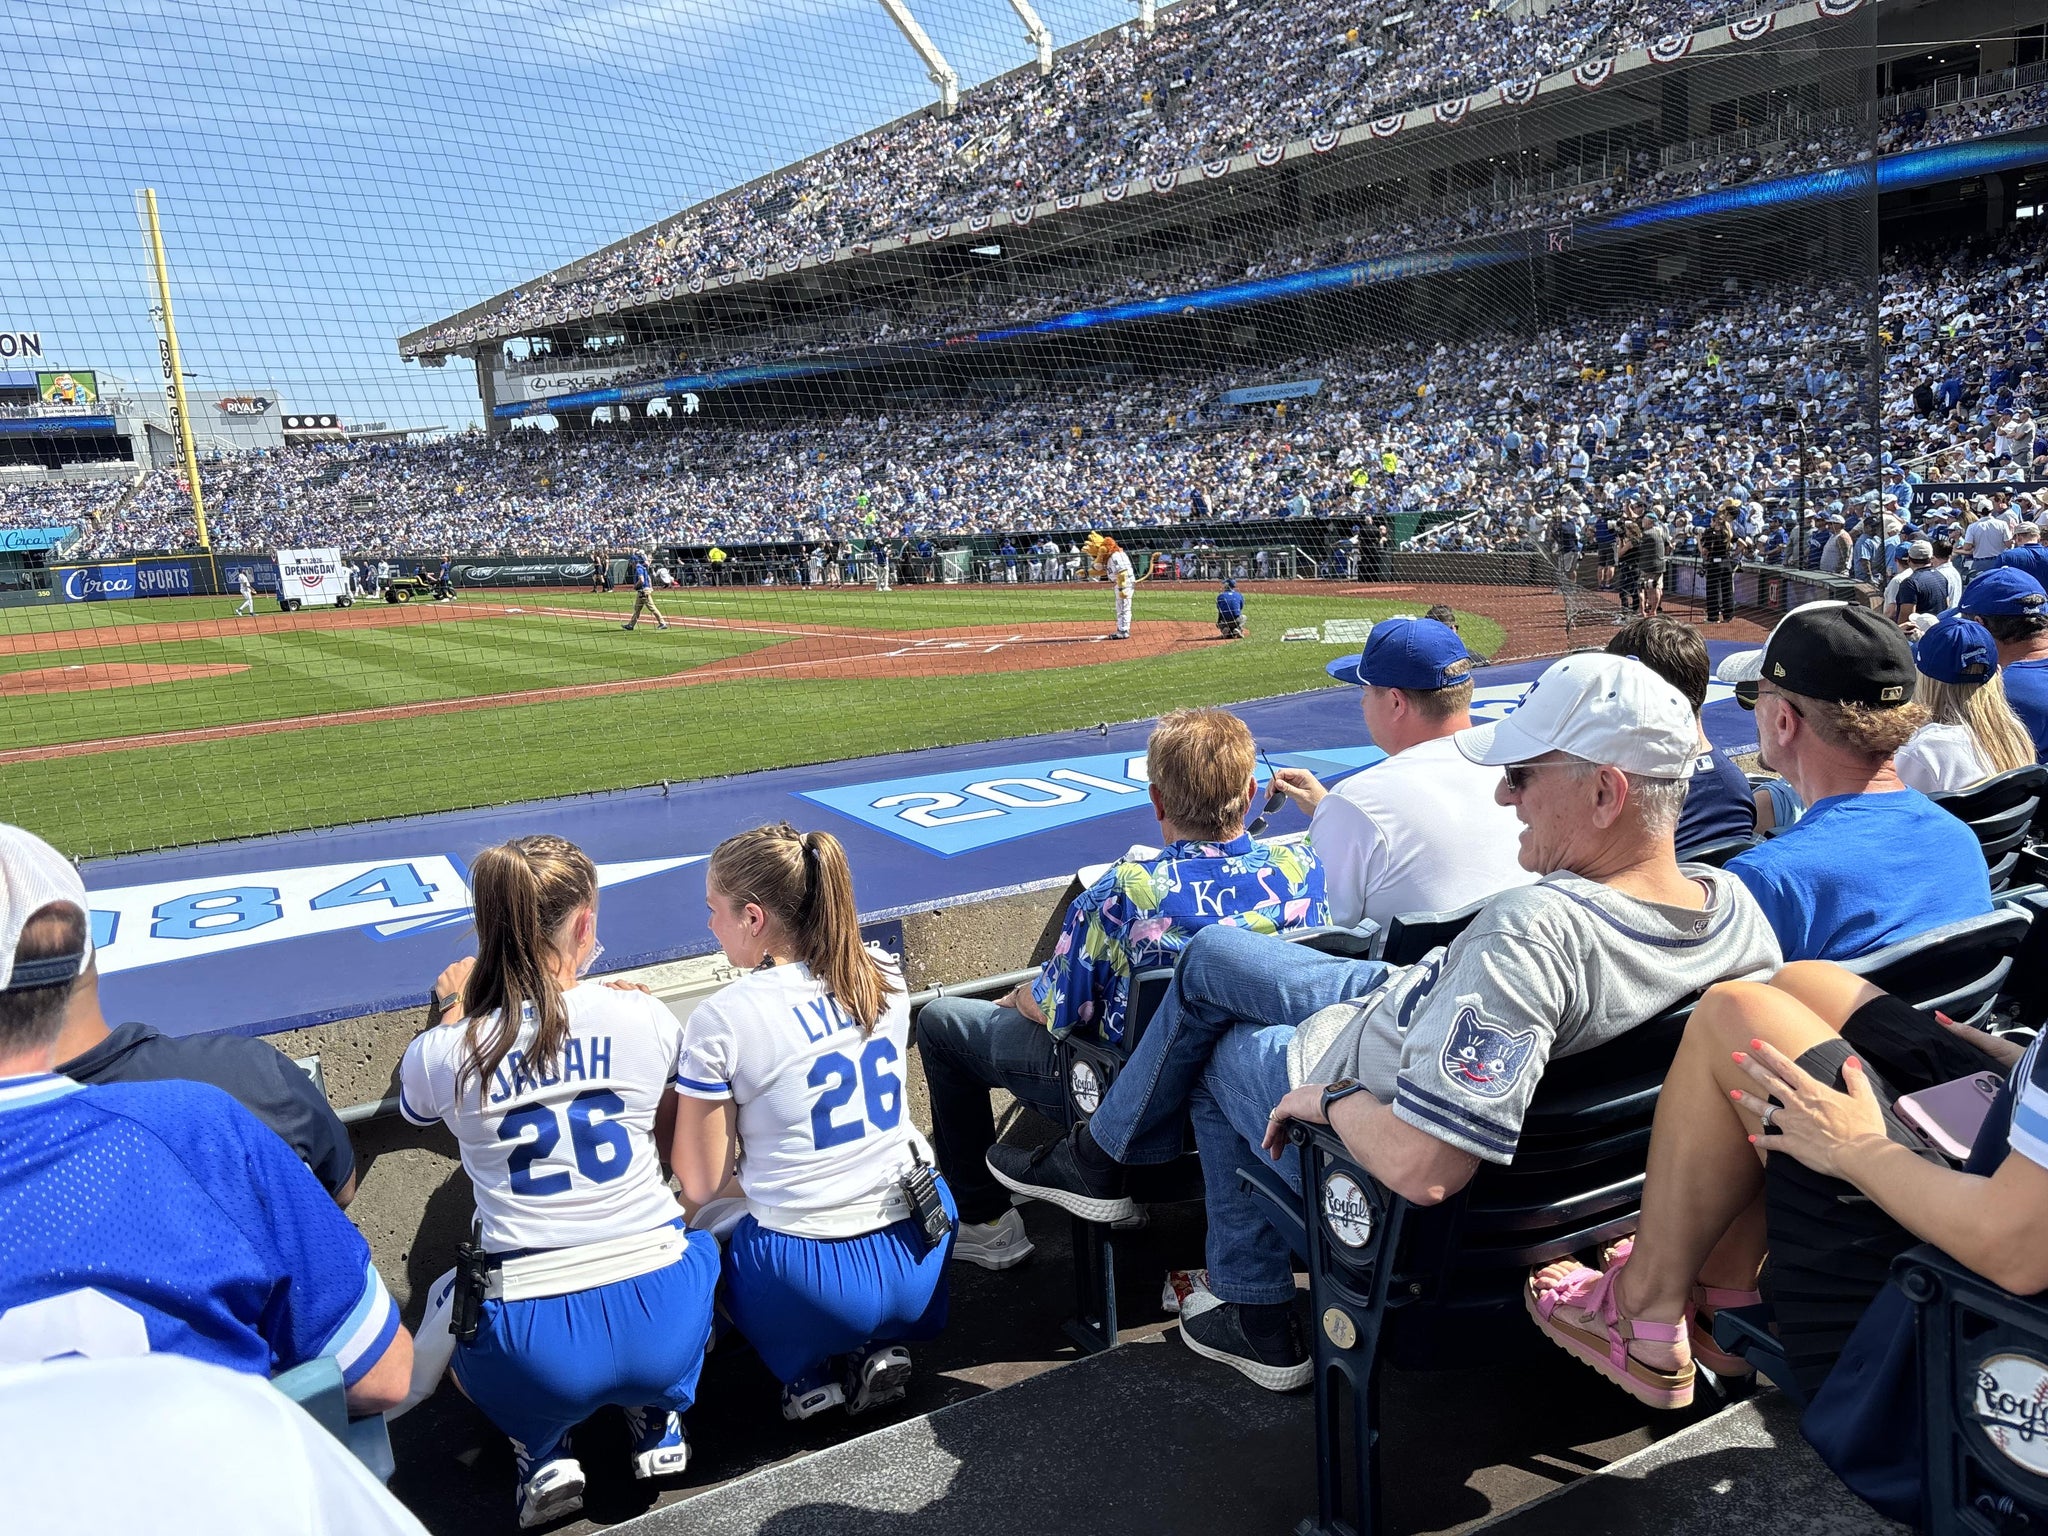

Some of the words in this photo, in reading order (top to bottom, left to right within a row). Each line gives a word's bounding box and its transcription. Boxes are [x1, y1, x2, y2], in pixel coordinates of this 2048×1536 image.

[227, 400, 264, 413] RIVALS
[5, 531, 42, 549] Circa
[284, 565, 320, 576] OPENING
[319, 564, 335, 575] DAY
[65, 569, 133, 600] Circa
[137, 568, 189, 590] SPORTS
[806, 1036, 903, 1150] 26
[496, 1087, 634, 1196] 26
